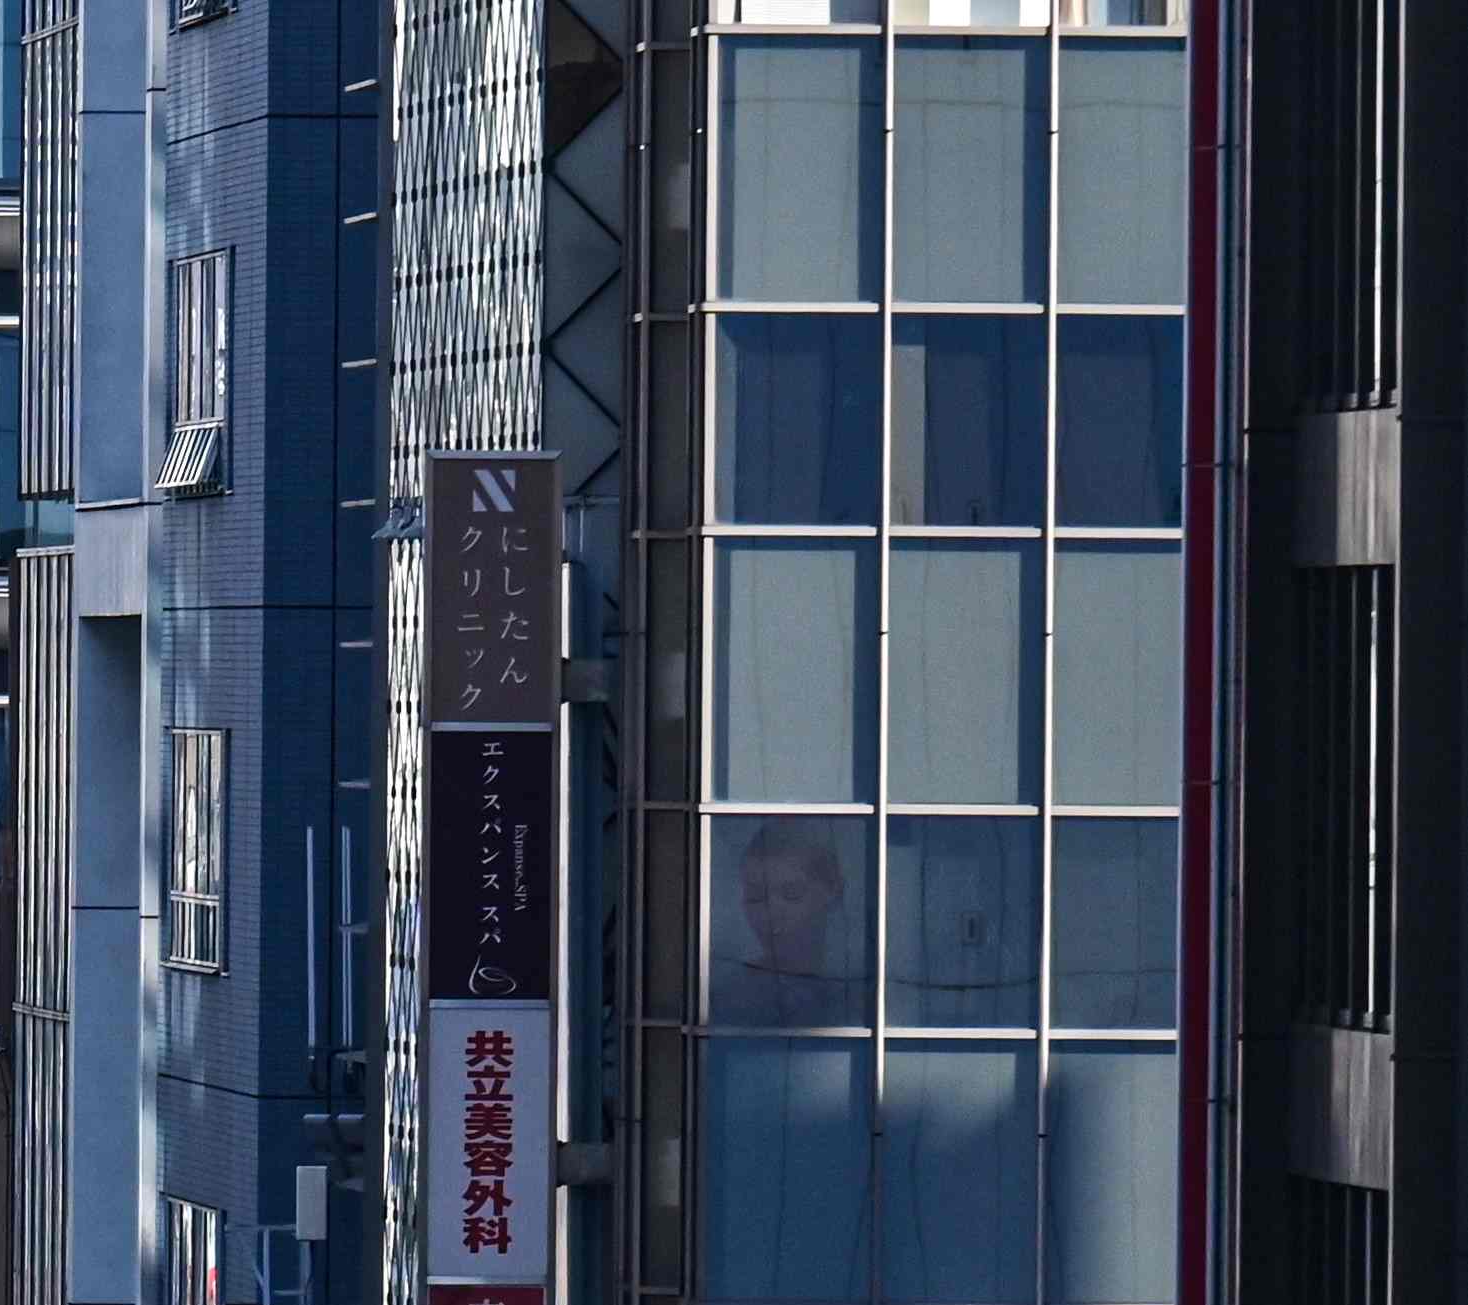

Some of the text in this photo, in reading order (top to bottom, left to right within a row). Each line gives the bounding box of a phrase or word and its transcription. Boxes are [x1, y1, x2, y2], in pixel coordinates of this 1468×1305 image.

[457, 525, 485, 712] クリニック
[499, 525, 530, 685] にしたん
[479, 741, 505, 889] エクスパンス
[462, 1030, 515, 1255] 共立美容外科
